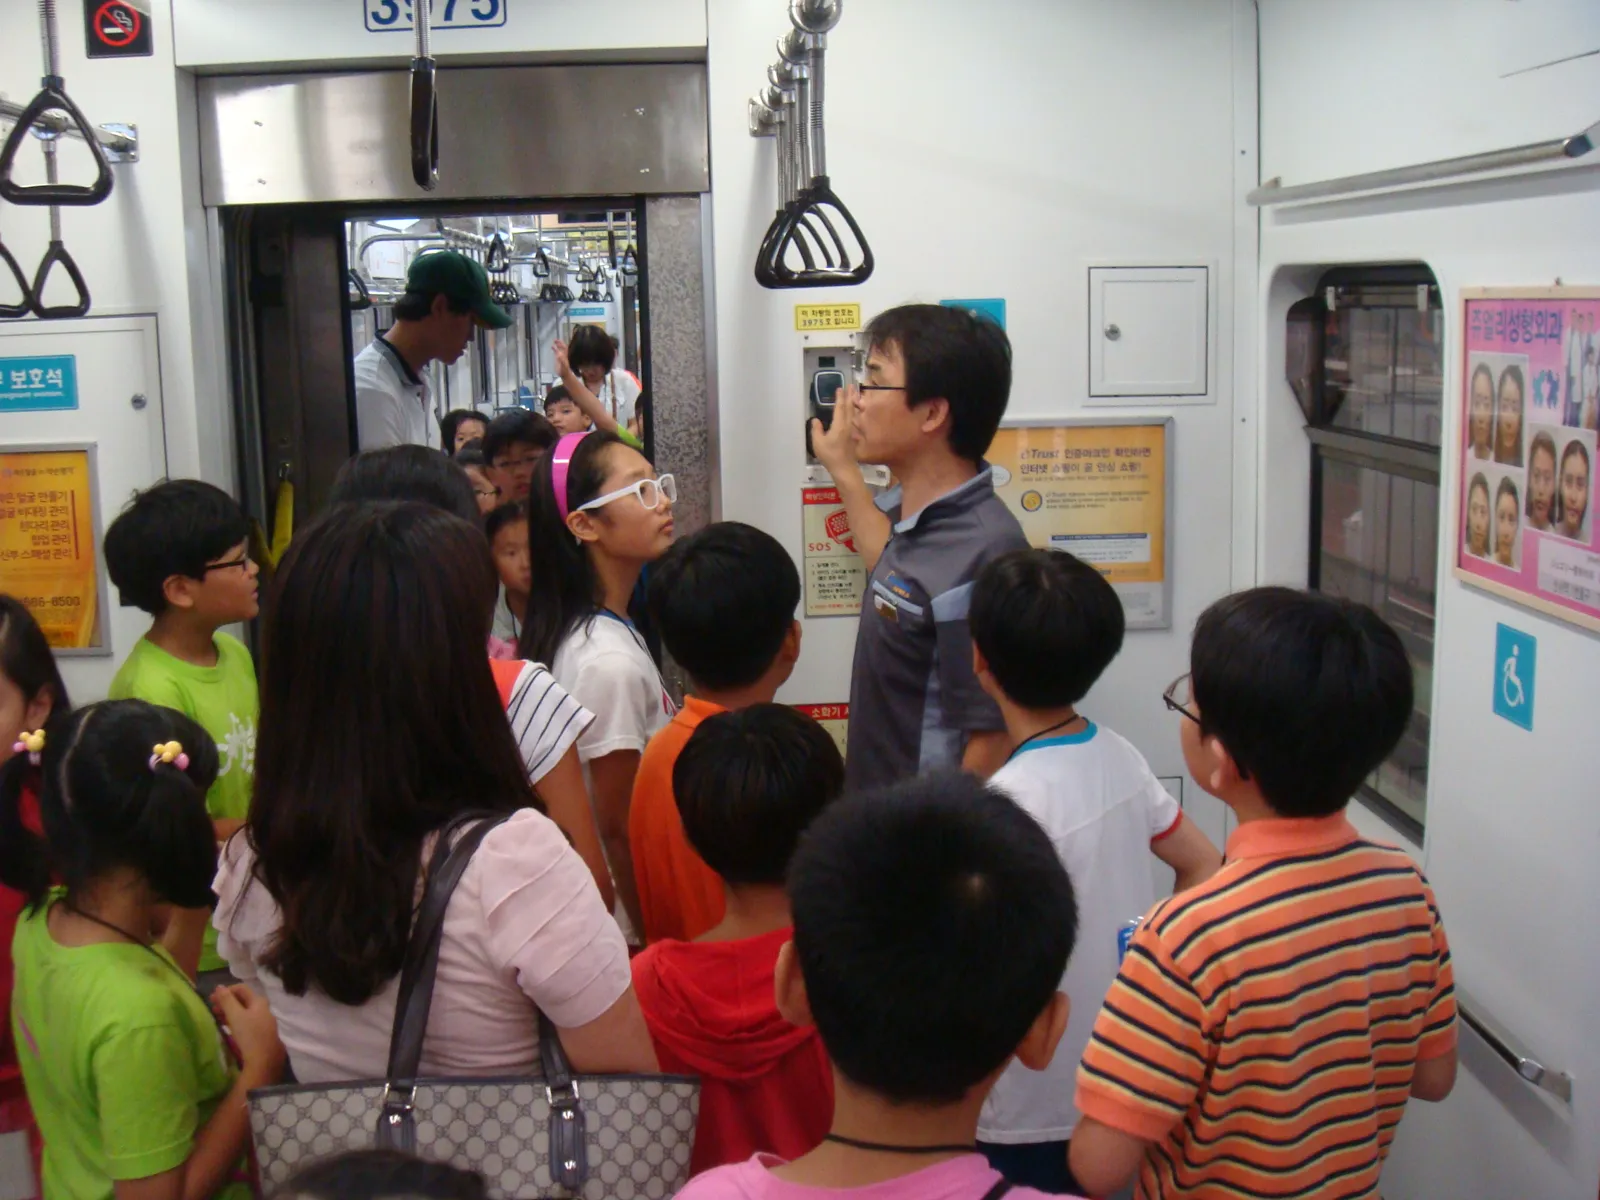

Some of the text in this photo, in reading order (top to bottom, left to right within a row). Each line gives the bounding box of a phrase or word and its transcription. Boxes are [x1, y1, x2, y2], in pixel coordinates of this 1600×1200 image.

[371, 0, 500, 25] 375
[834, 308, 853, 317] 번호는
[10, 368, 63, 389] 보호석
[1020, 464, 1048, 474] 인터넷
[808, 542, 832, 552] SOS
[811, 706, 840, 718] 소화기
